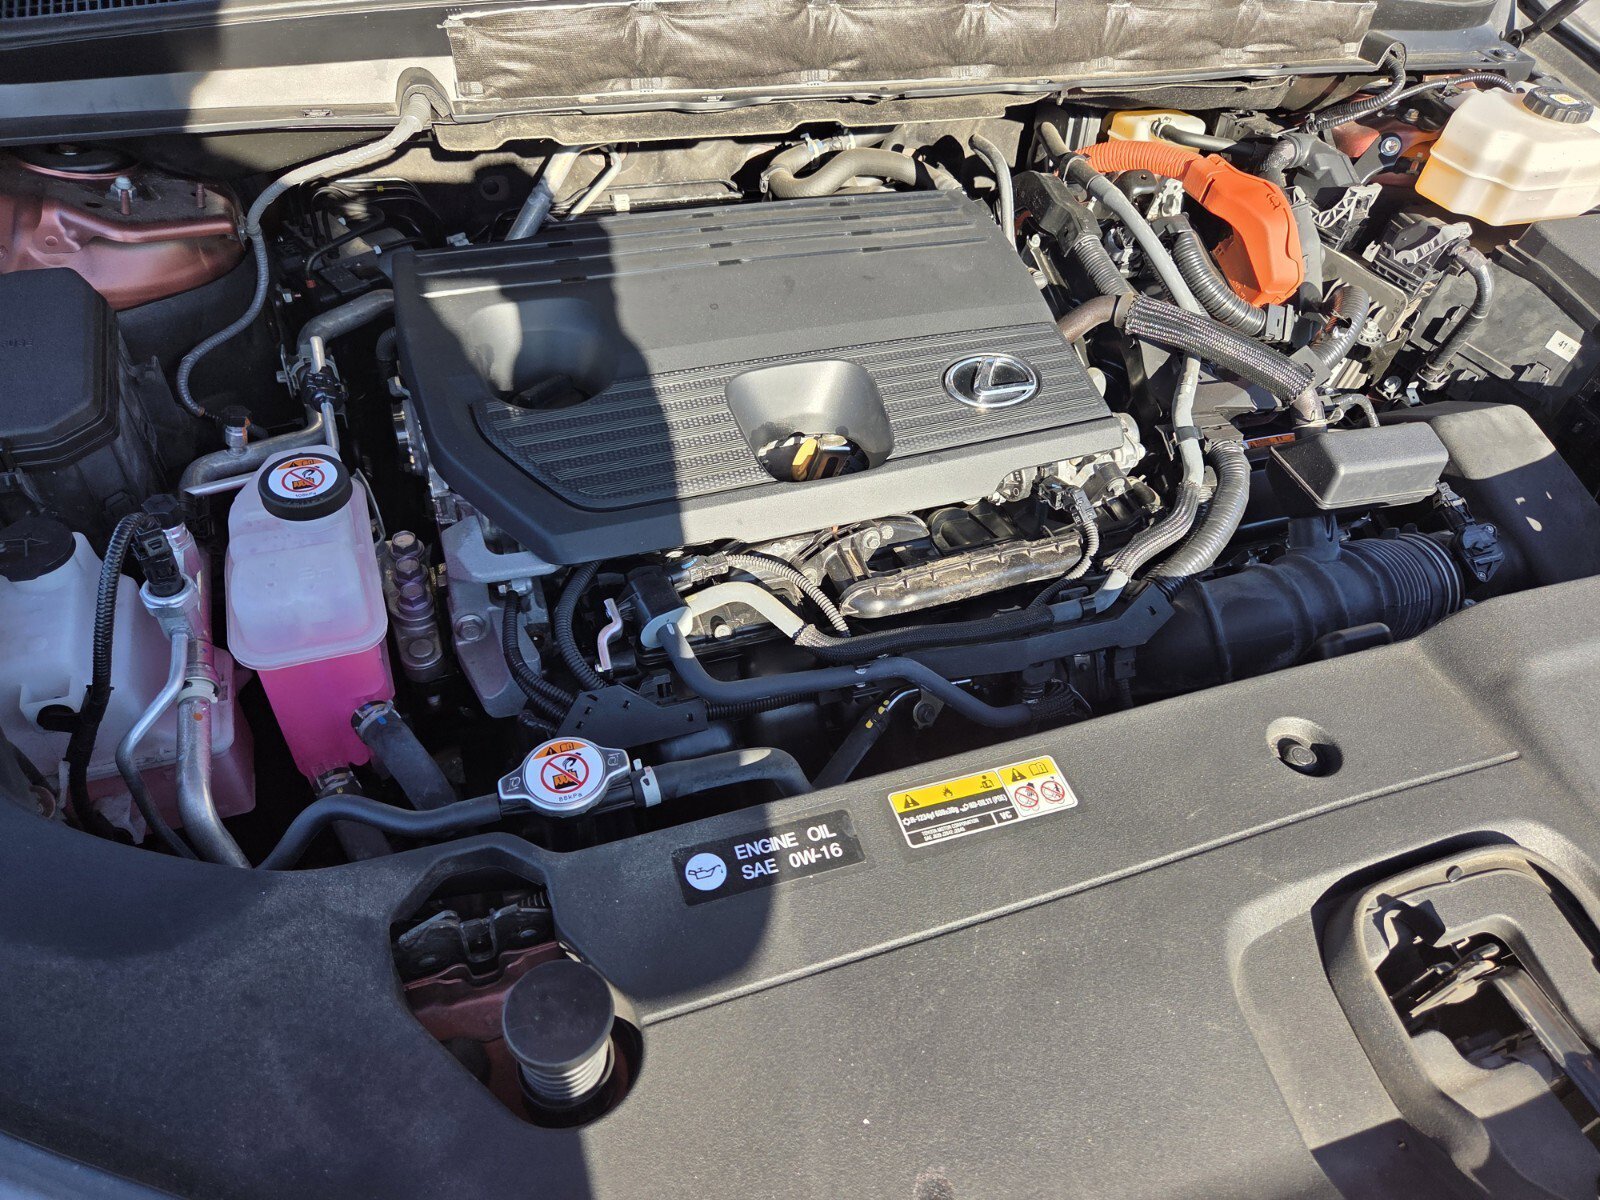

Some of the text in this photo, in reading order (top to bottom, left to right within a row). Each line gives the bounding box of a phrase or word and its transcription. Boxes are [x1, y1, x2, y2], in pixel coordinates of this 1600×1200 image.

[999, 811, 1012, 820] VC
[734, 824, 837, 860] ENGINE OIL
[741, 842, 843, 880] SAE 0W-16
